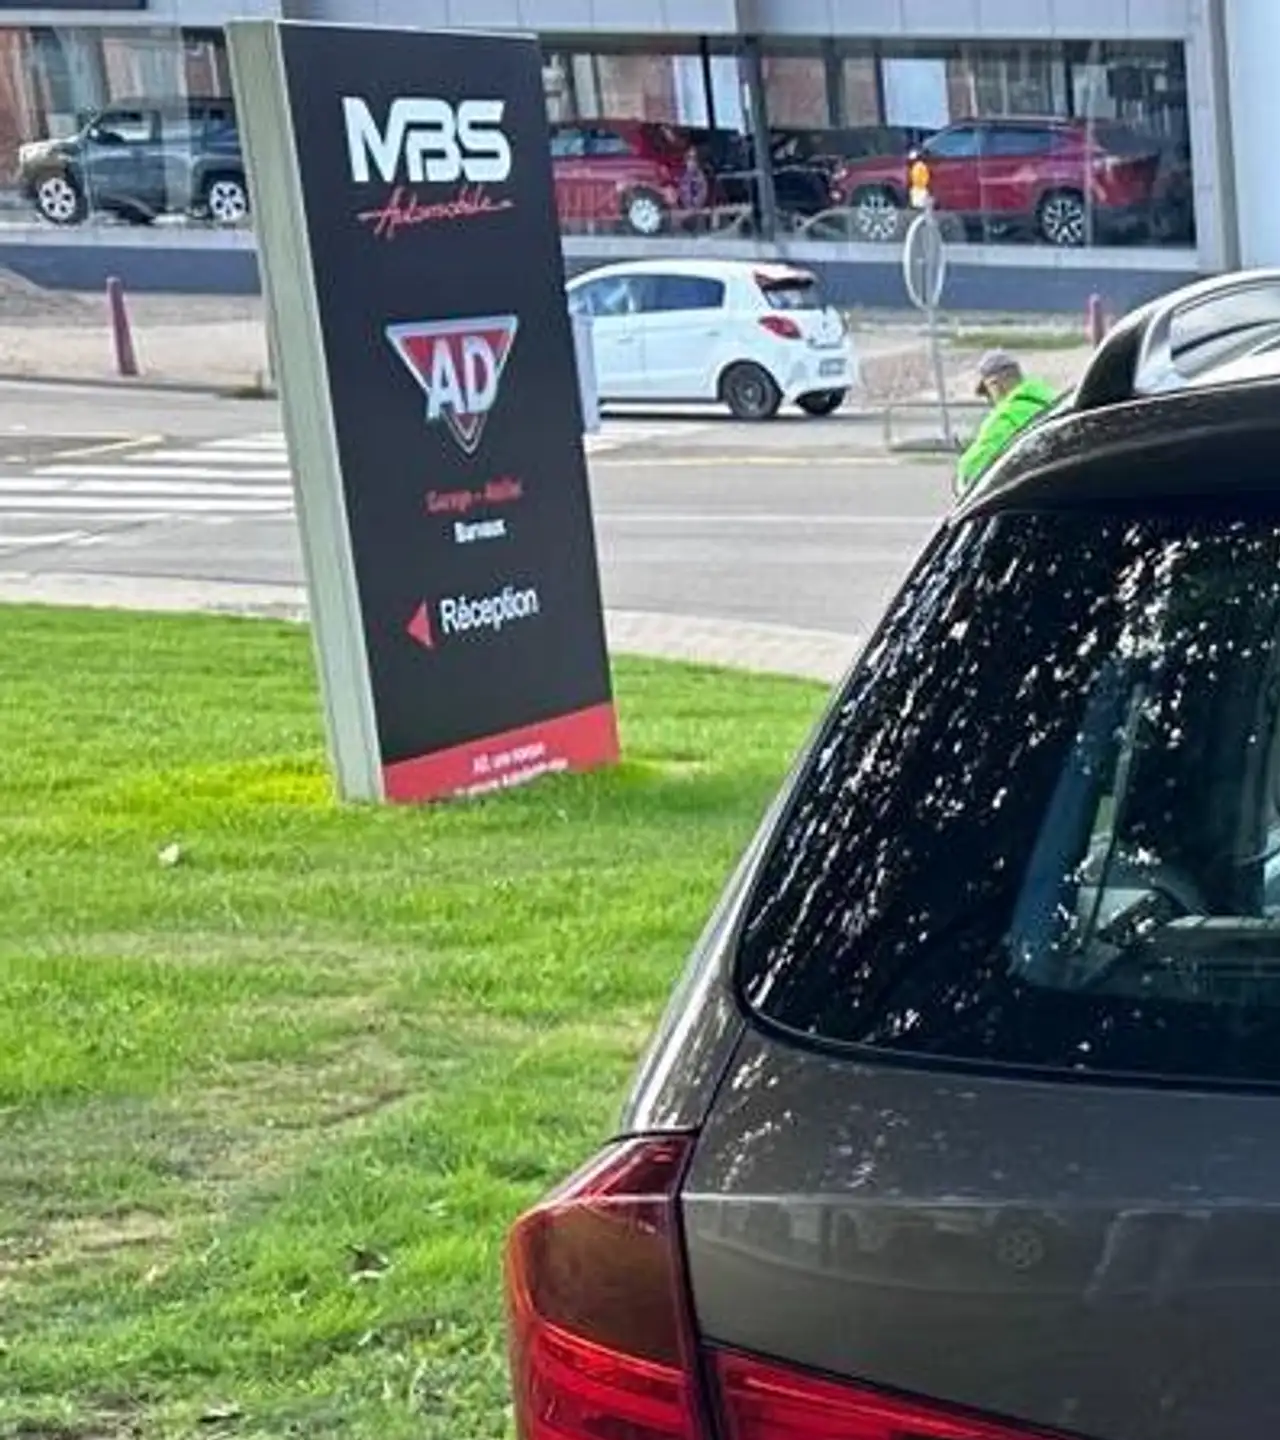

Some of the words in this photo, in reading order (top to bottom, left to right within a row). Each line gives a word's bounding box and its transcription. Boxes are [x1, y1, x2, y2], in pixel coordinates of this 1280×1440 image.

[341, 97, 512, 182] MBS
[426, 335, 498, 419] AD
[441, 586, 539, 635] Réception
